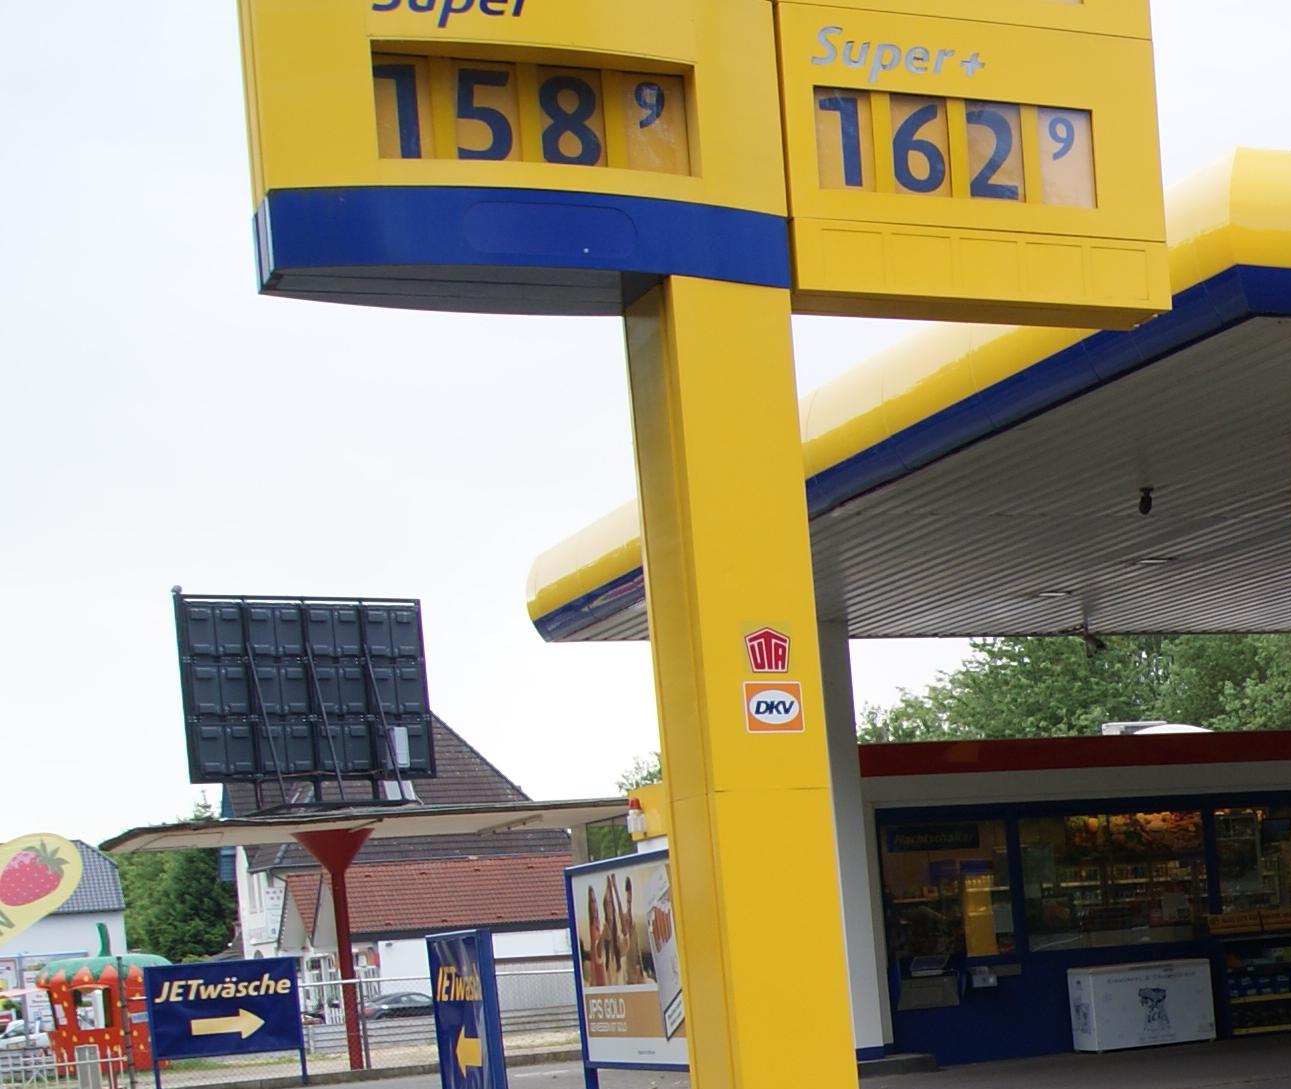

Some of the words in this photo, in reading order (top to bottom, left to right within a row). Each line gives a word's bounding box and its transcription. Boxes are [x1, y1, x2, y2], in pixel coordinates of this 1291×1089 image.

[747, 630, 788, 670] UTA
[754, 700, 795, 715] DKV
[154, 973, 291, 1004] JETwäsche
[604, 998, 626, 1019] GOLD
